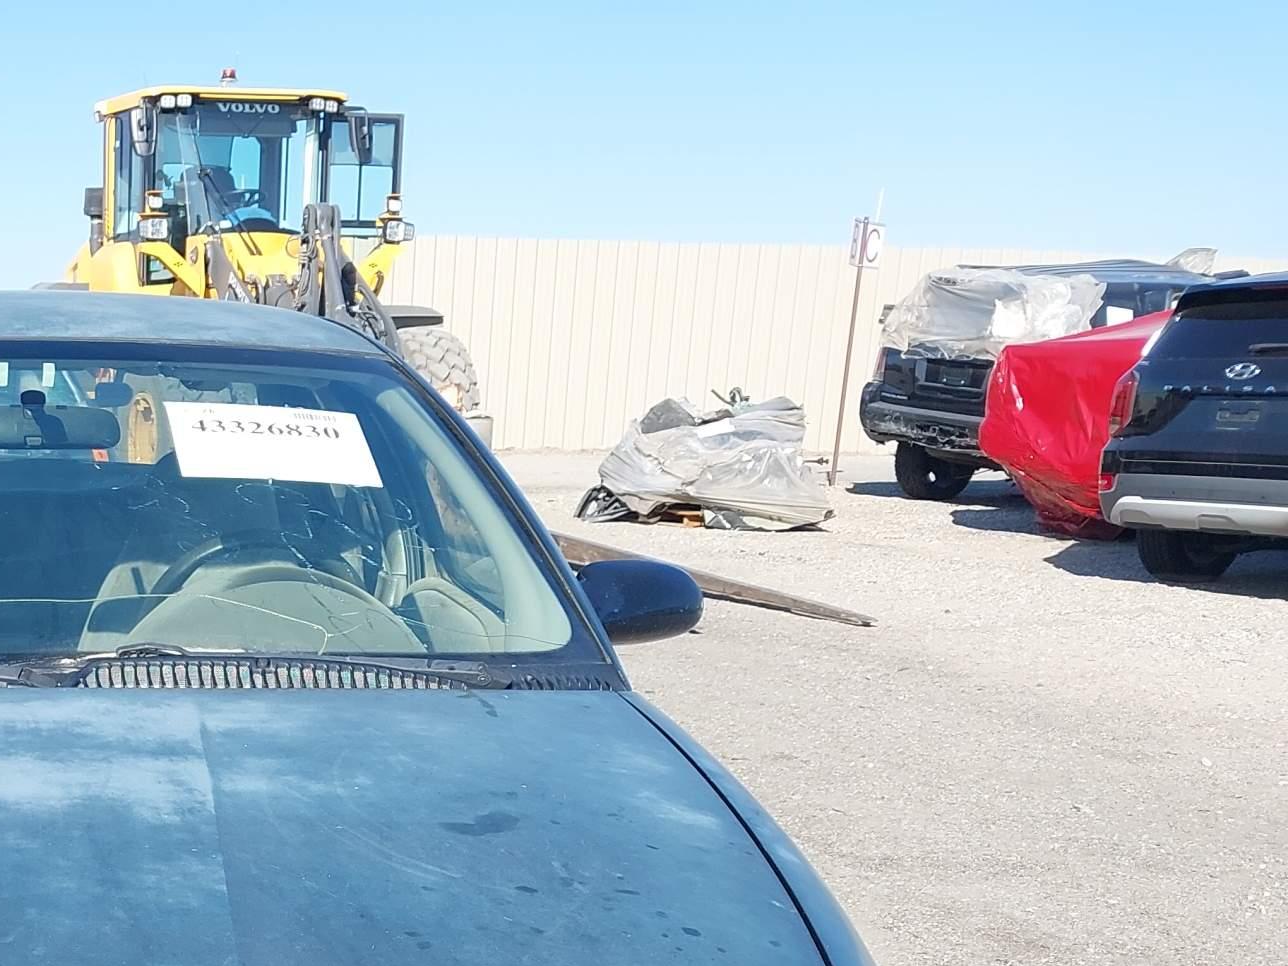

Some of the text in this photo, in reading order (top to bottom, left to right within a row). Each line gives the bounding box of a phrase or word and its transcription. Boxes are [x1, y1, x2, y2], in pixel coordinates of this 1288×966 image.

[216, 102, 280, 114] VOLVO
[865, 228, 881, 263] C
[191, 418, 340, 440] 43326830
